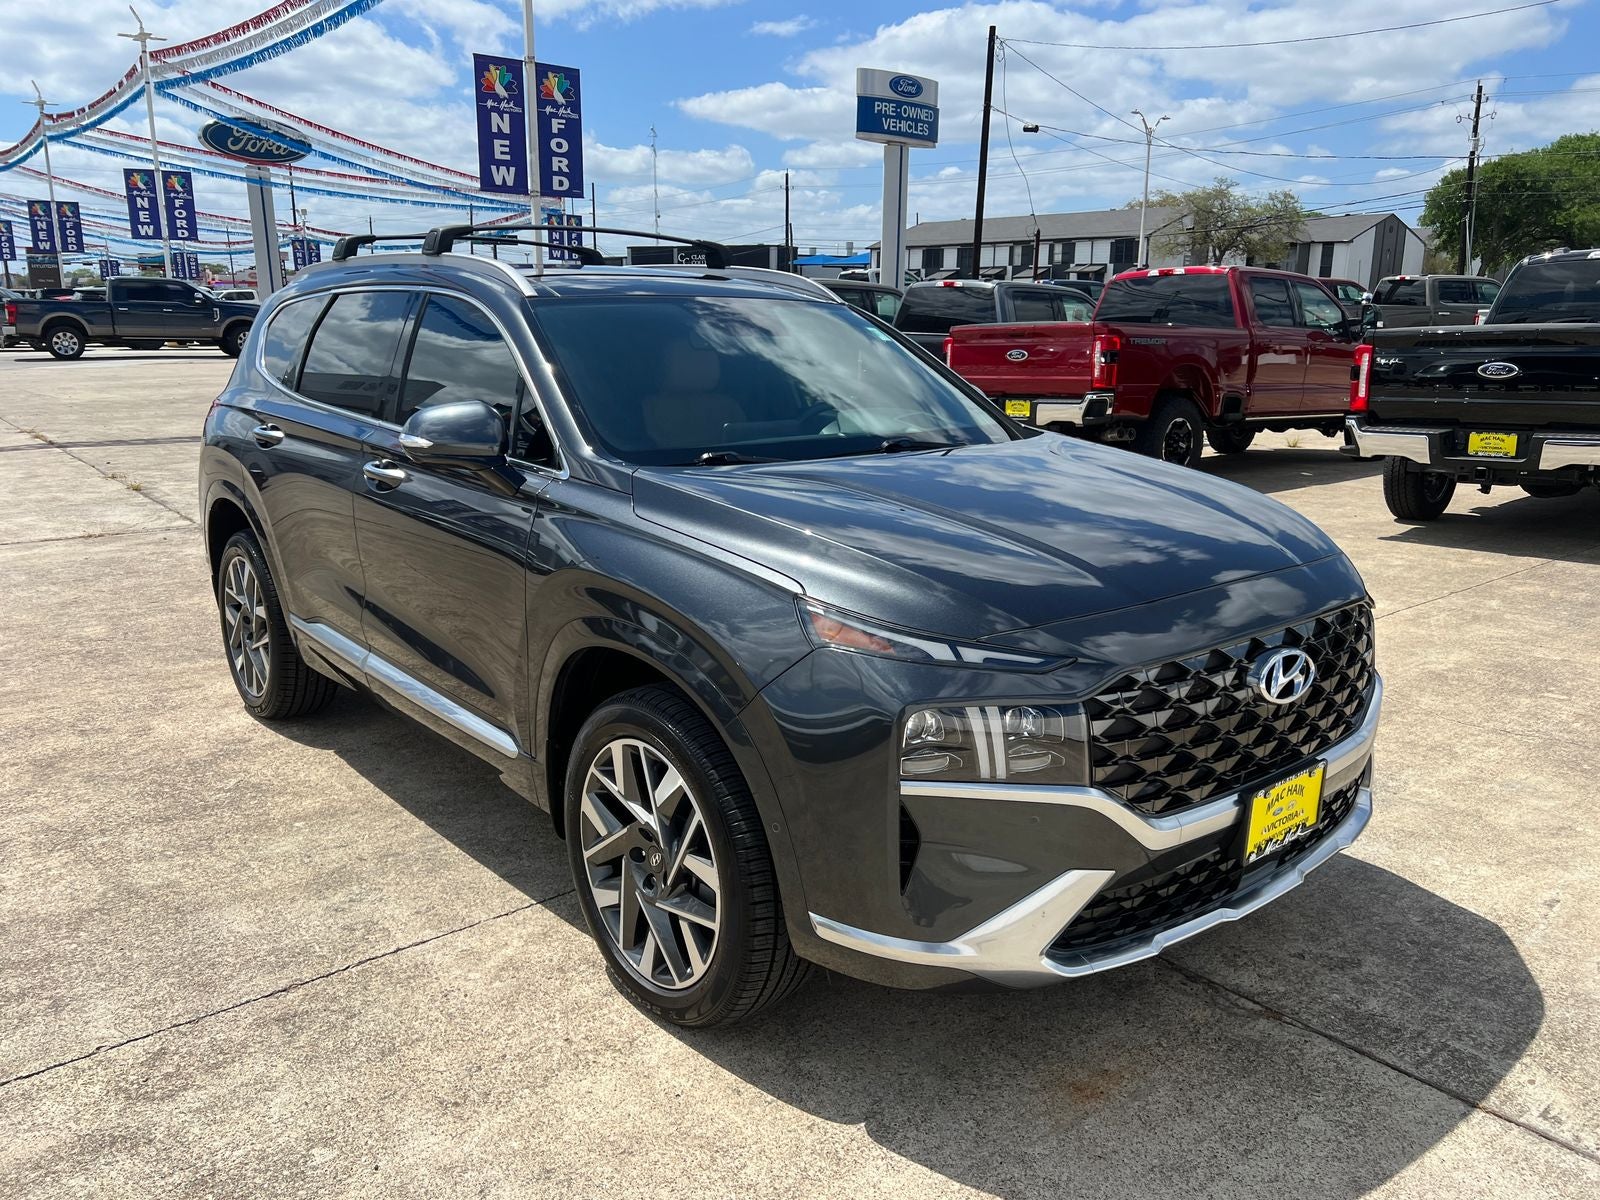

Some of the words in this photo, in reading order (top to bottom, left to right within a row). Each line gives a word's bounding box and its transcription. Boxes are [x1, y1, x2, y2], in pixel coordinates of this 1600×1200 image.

[898, 79, 917, 94] Ford
[882, 118, 929, 136] VEHICLES
[491, 112, 516, 187] NEW
[550, 118, 570, 191] FORD
[136, 197, 154, 236] NEW
[174, 199, 189, 238] FORD
[36, 221, 51, 250] NEW
[66, 222, 78, 251] FORD
[571, 233, 579, 259] FOD
[1486, 365, 1509, 375] Ford
[1265, 788, 1287, 815] MAC
[1286, 784, 1306, 798] HAIK
[1267, 810, 1300, 833] VICTORIA
